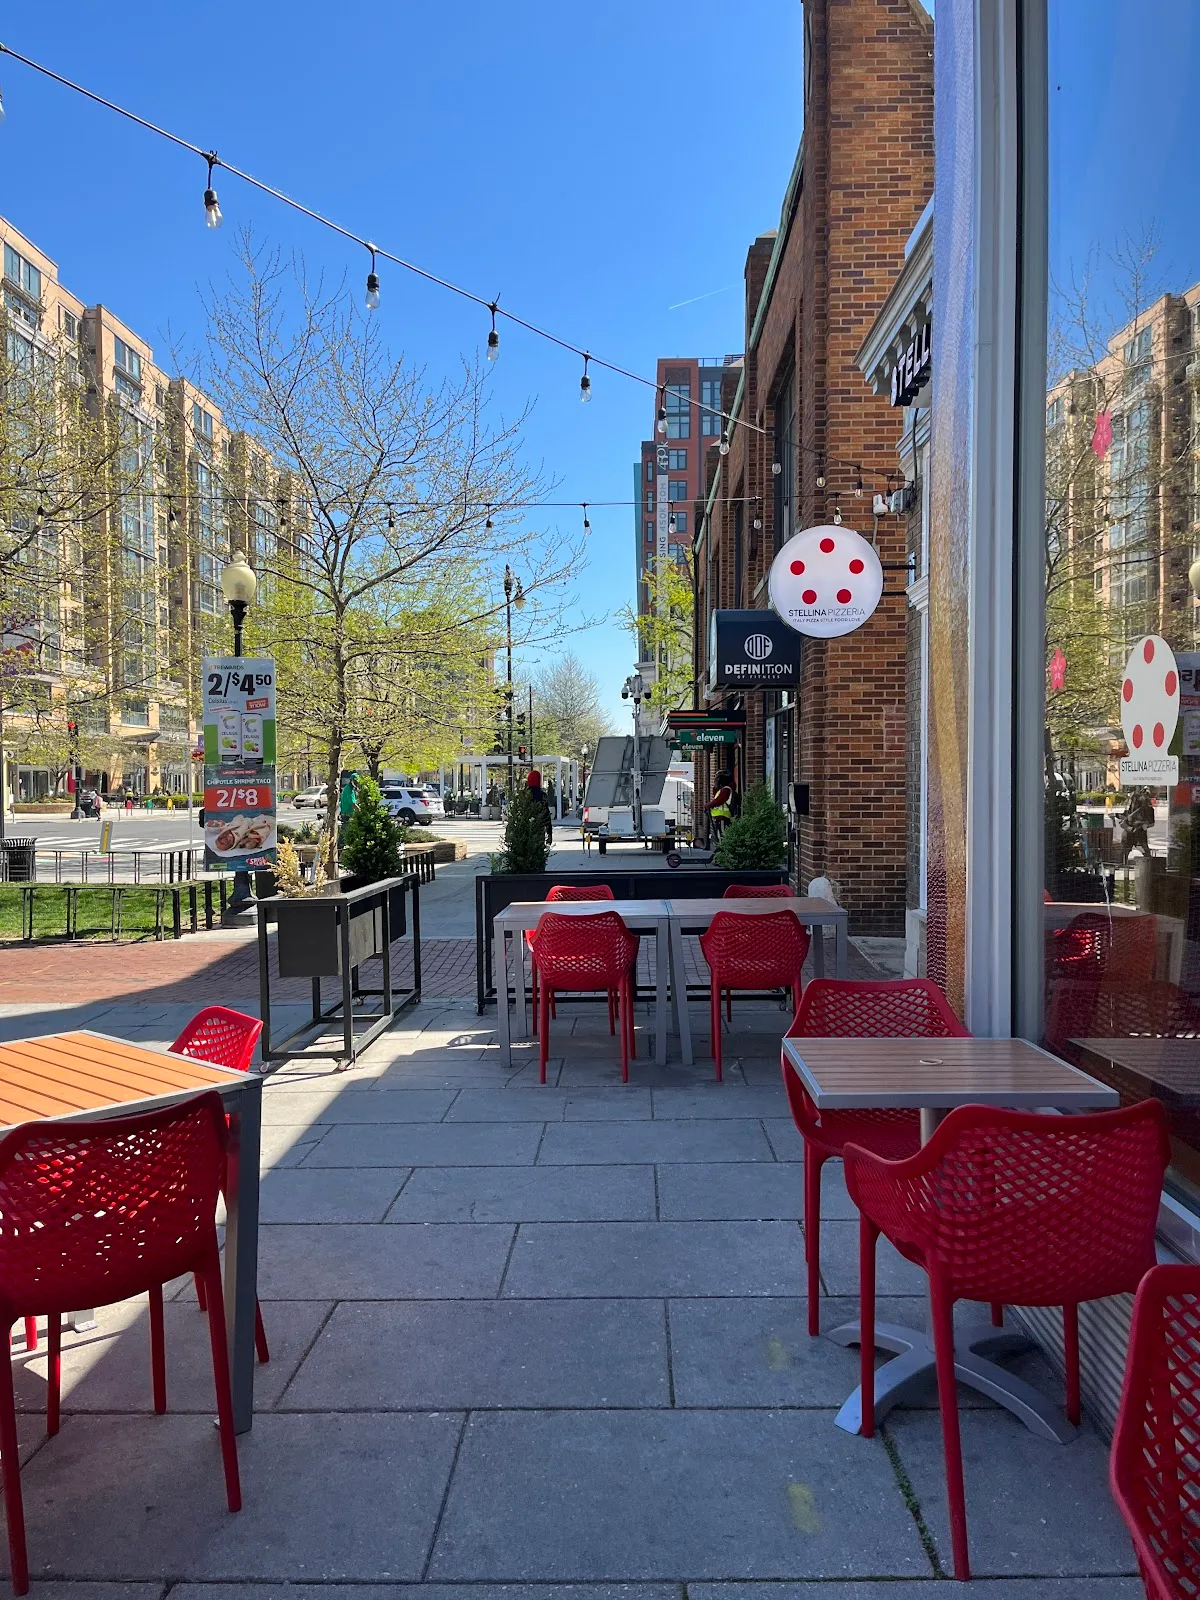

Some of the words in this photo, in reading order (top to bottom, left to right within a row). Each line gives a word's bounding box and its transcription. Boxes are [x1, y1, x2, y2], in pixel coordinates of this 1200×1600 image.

[788, 609, 827, 617] STELLINA
[827, 608, 866, 616] PIZZERIA
[1121, 761, 1147, 772] STELLINA
[1148, 760, 1177, 772] PIZZERIA
